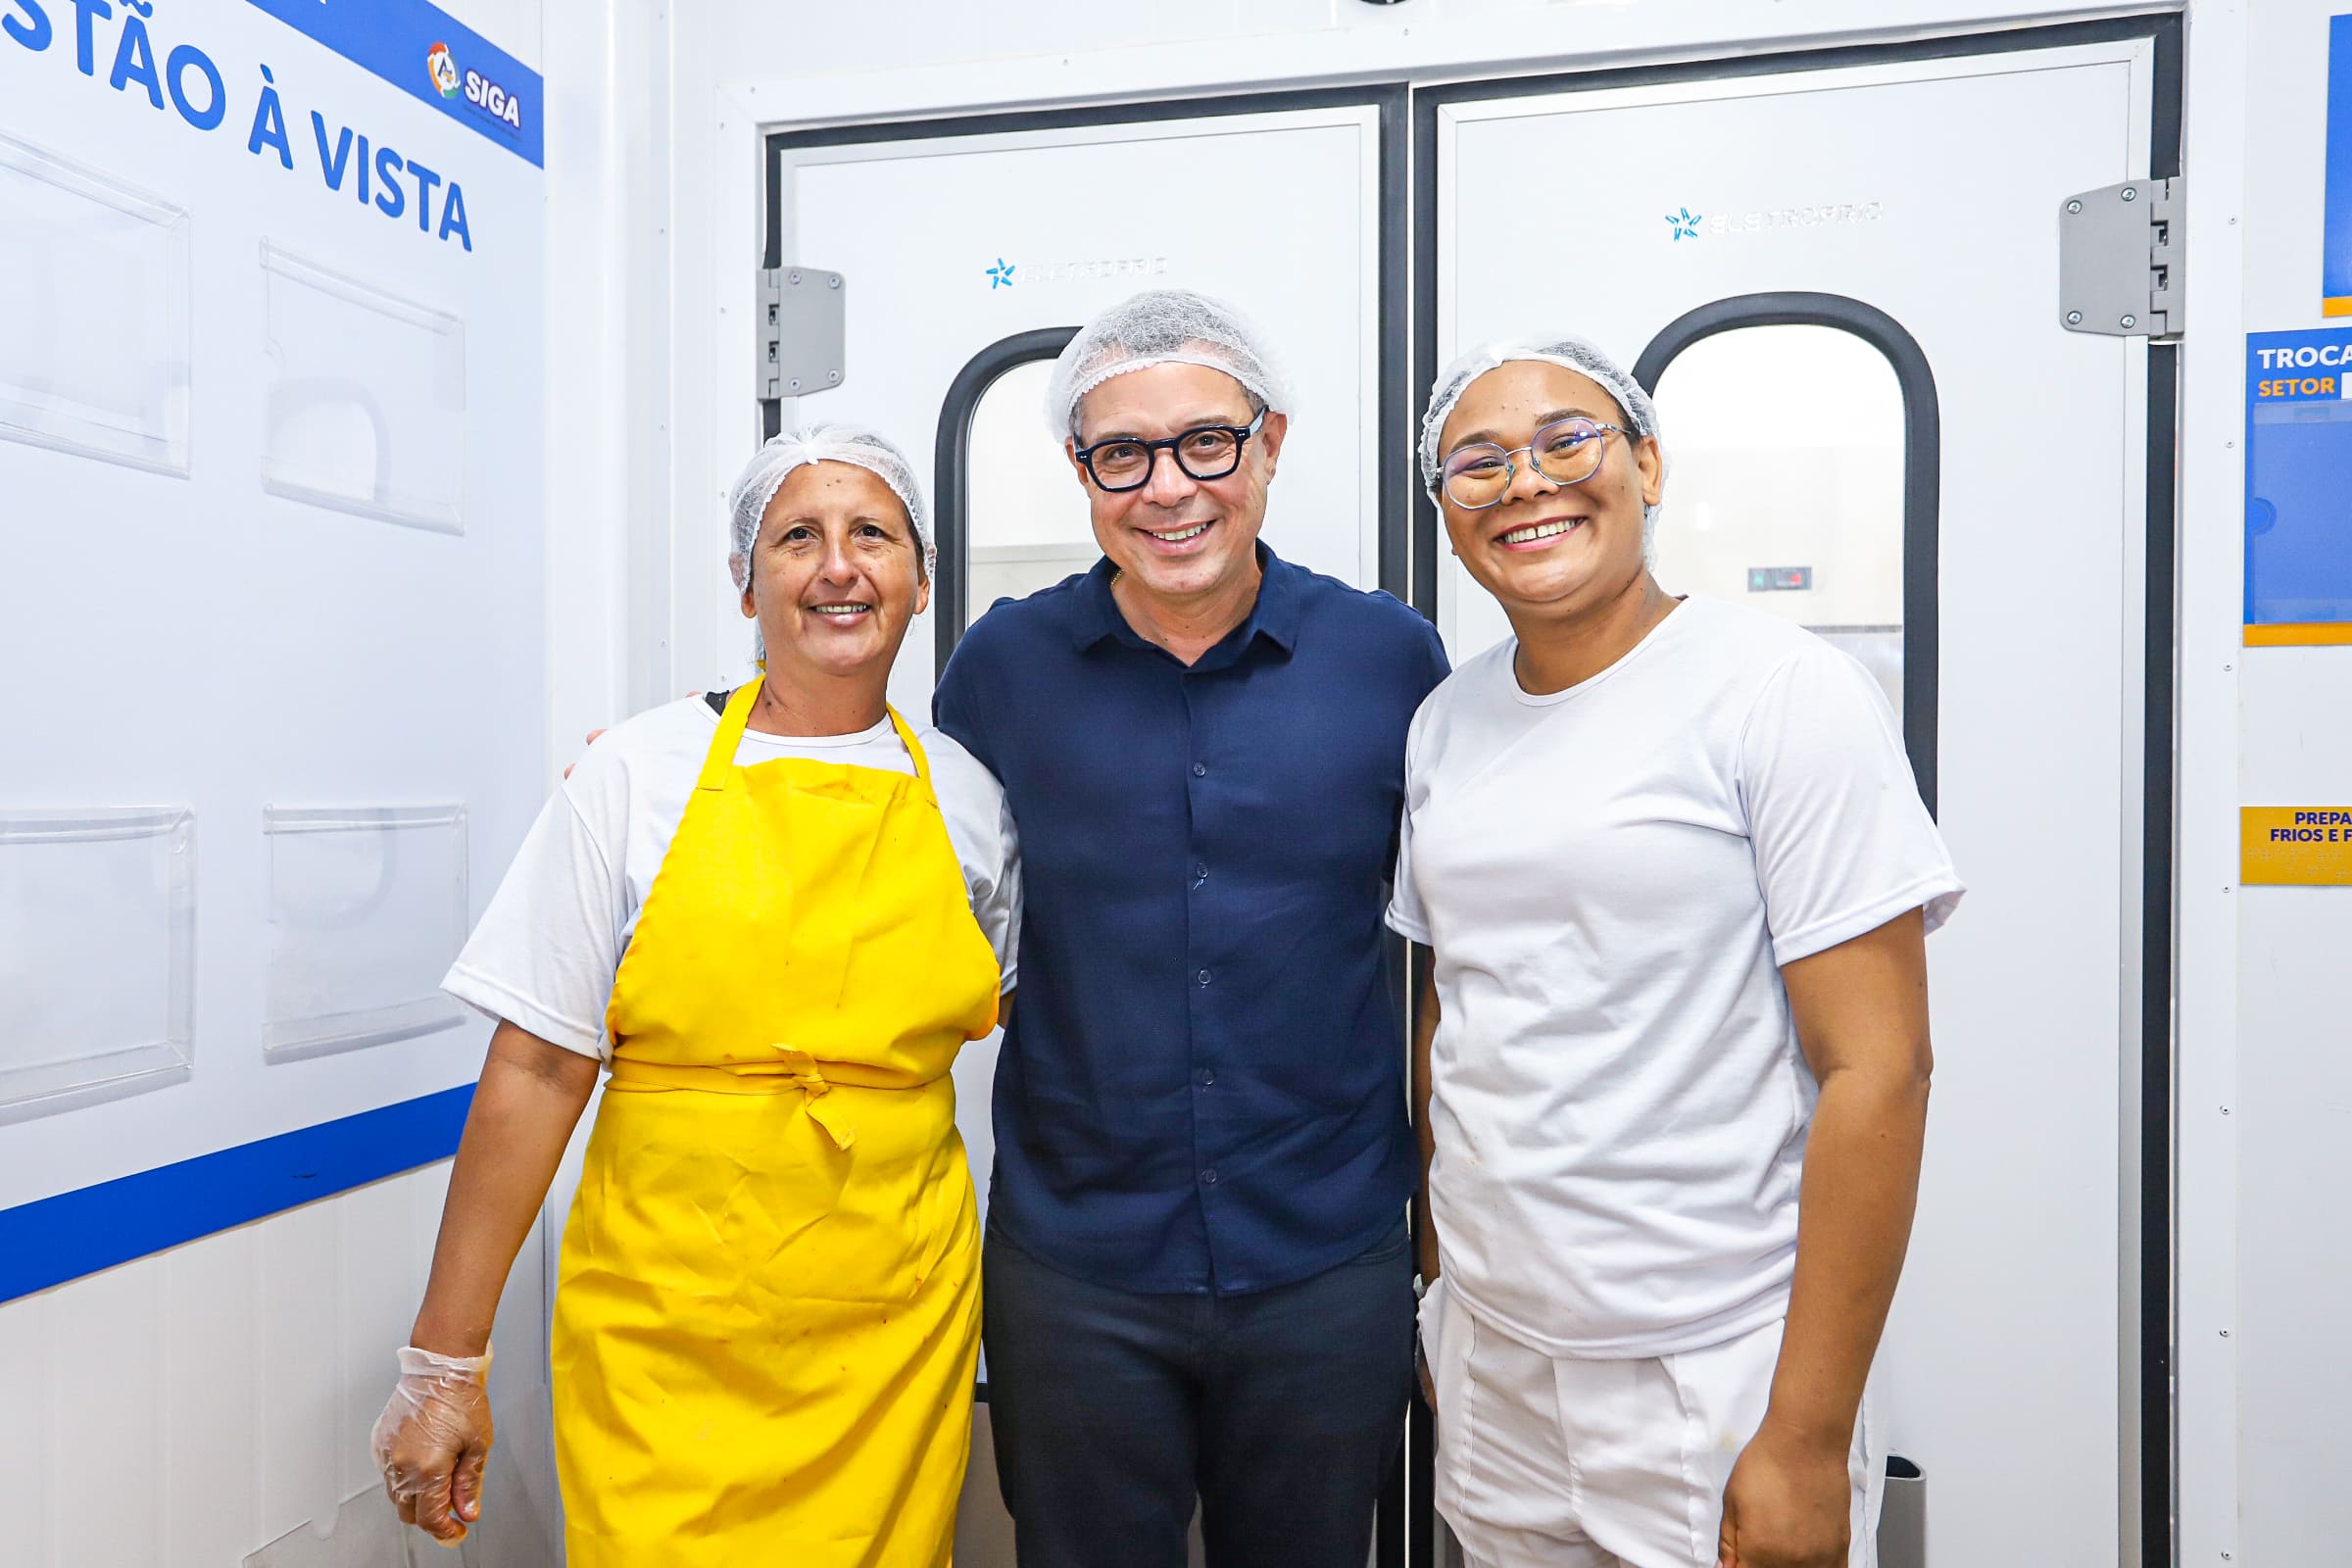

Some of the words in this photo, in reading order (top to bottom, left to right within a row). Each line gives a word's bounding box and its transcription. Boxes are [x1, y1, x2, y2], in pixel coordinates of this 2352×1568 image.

[464, 69, 522, 130] SIGA
[0, 0, 226, 131] STÃO
[248, 63, 293, 171] À
[311, 109, 472, 253] VISTA
[2257, 345, 2352, 369] TROCA
[2258, 377, 2335, 397] SETOR
[2294, 811, 2352, 825] PREPA
[2270, 828, 2324, 842] FRIOS
[2328, 829, 2338, 842] E
